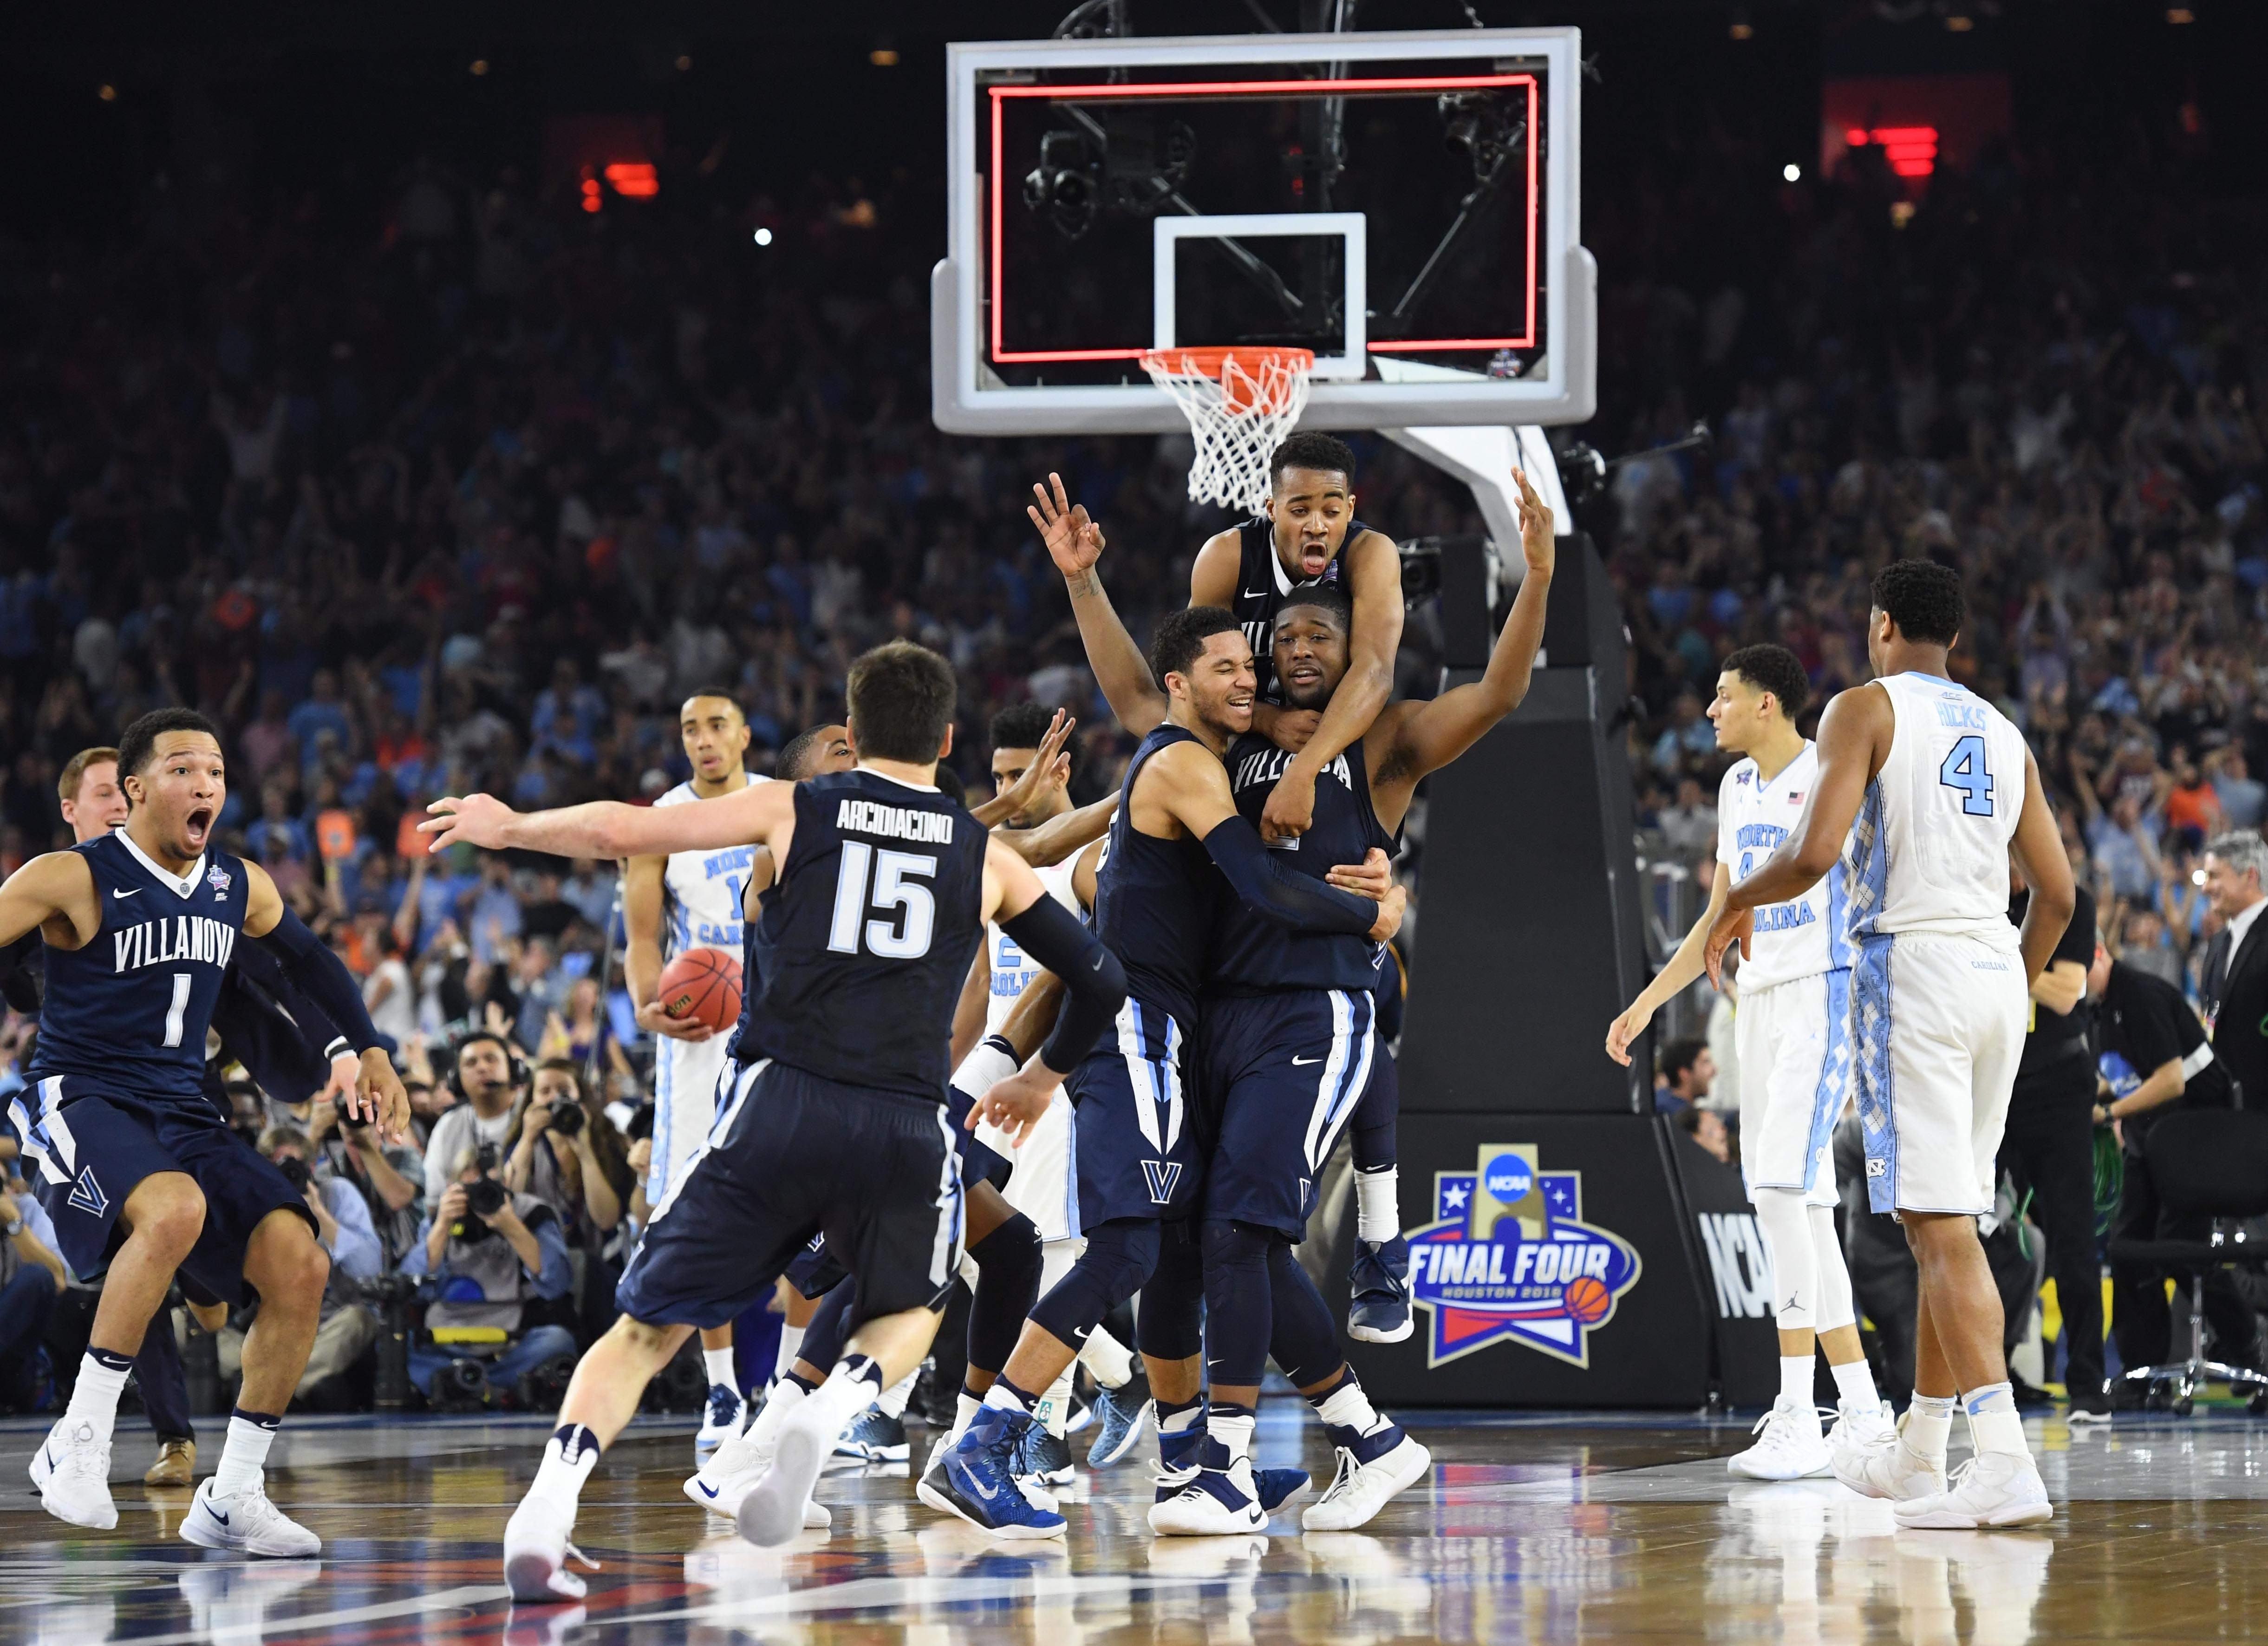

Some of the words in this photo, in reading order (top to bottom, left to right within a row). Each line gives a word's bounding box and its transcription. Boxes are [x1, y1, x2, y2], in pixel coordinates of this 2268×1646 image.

[1939, 691, 1963, 700] ACC
[1933, 701, 1986, 732] HICKS
[1939, 735, 1994, 817] 4
[836, 799, 954, 845] ARCIDIACONO
[827, 839, 938, 959] 15
[1971, 960, 2009, 971] CAROLINA
[161, 973, 192, 1048] 1
[1488, 1175, 1532, 1192] NCAA
[1408, 1244, 1507, 1285] FINAL
[1512, 1244, 1611, 1285] FOUR
[1441, 1286, 1517, 1299] HOUSTON
[1521, 1286, 1563, 1299] 2016
